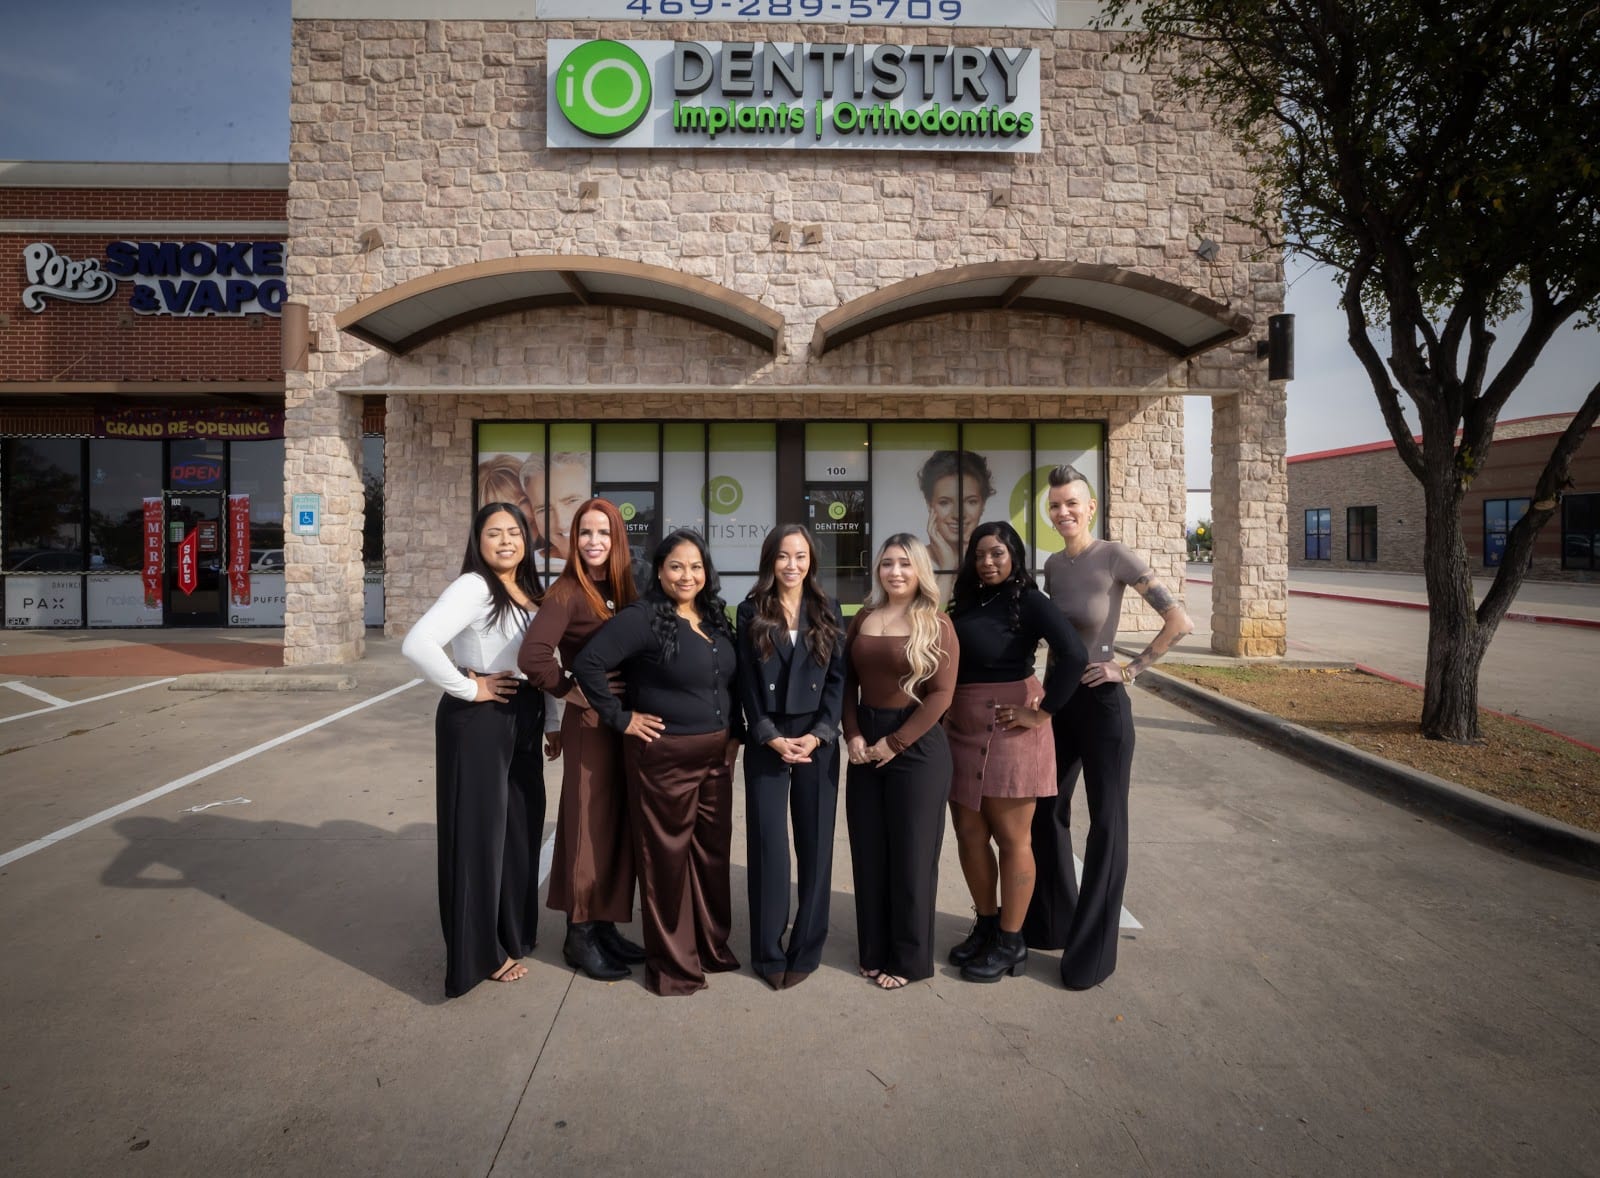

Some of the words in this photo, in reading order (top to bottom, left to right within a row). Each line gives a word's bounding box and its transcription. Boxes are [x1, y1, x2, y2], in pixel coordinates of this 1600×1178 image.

[625, 0, 963, 21] 469-289-5709
[673, 41, 1033, 103] DENTISTRY
[563, 57, 643, 118] iO
[673, 100, 806, 138] Implants
[833, 102, 1035, 138] Orthodontics
[105, 241, 285, 277] SMOKE
[105, 421, 164, 437] GRAND
[167, 420, 270, 437] RE-OPENING
[171, 464, 222, 481] OPEN
[826, 467, 847, 476] 100
[171, 498, 182, 507] 102
[815, 522, 860, 531] DENTISTRY
[147, 522, 161, 590] MERRY
[182, 544, 192, 584] SALE
[233, 513, 246, 589] CHRISTMAS
[23, 597, 65, 610] PAX
